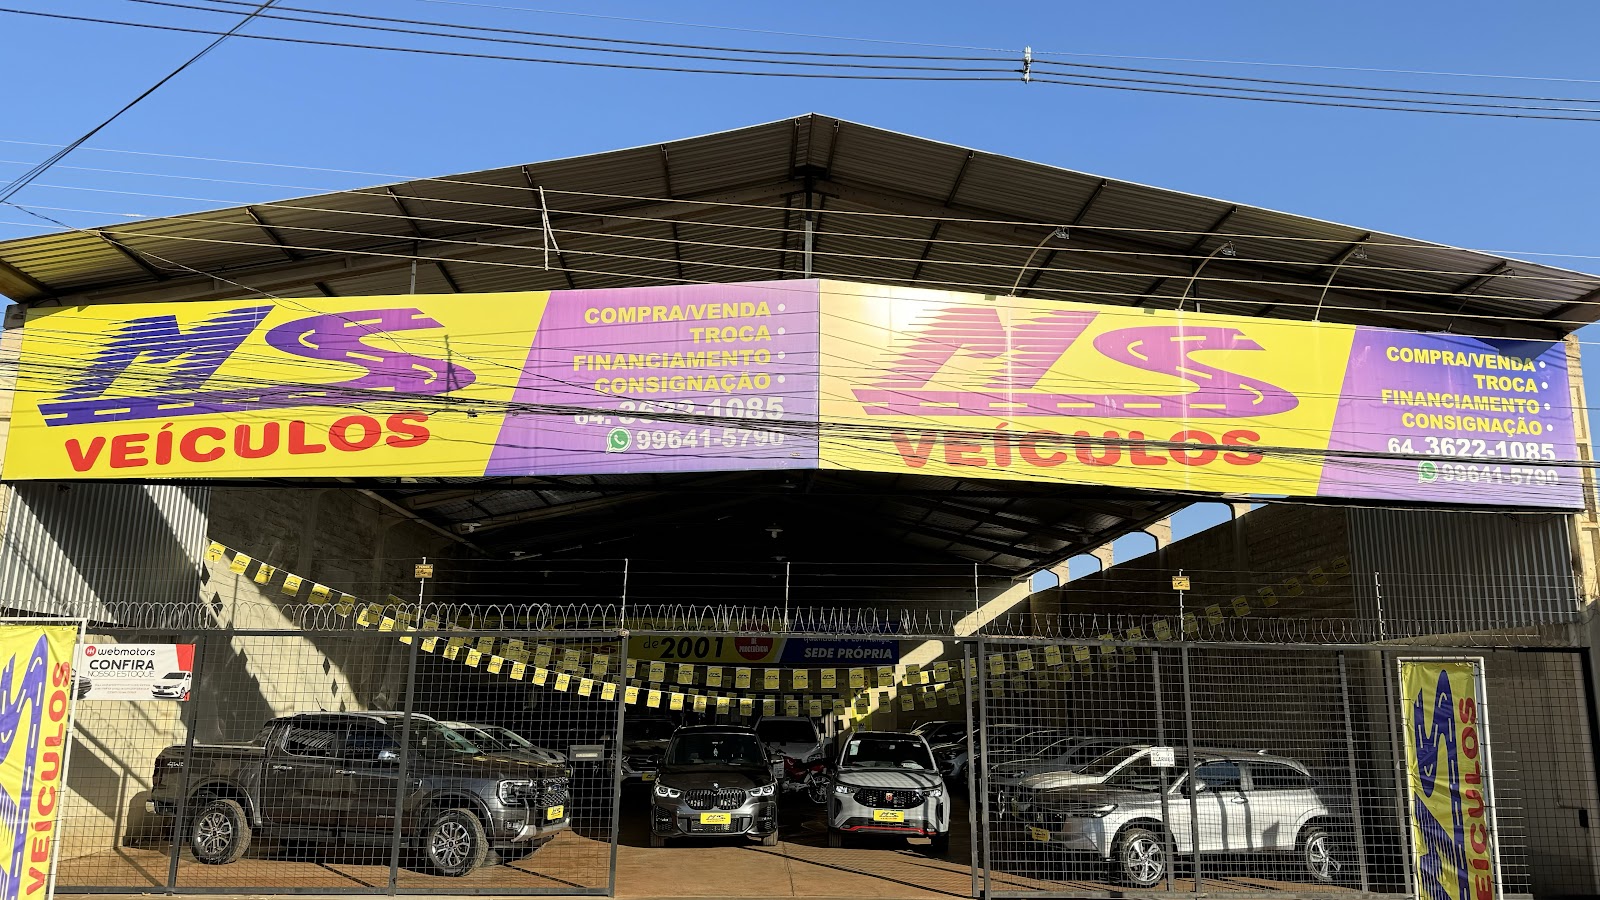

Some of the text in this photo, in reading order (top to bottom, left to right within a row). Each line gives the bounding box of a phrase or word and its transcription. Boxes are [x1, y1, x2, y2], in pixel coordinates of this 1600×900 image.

[584, 301, 771, 324] COMPRA/VENDA
[690, 325, 771, 344] TROCA
[37, 304, 477, 427] MS
[573, 349, 771, 371] FINANCIAMENTO
[851, 308, 1300, 417] MS
[1386, 346, 1536, 372] COMPRA/VENDA
[594, 371, 771, 394] CONSIGNAÇÃO
[1473, 374, 1538, 393] TROCA
[1381, 389, 1540, 415] FINANCIAMENTO
[1402, 413, 1543, 437] CONSIGNAÇÃO
[65, 412, 430, 472] VEÍCULOS
[889, 422, 1264, 468] VEÍCULOS
[1424, 437, 1556, 461] 3622-1085
[98, 647, 155, 656] webmotors
[660, 637, 724, 659] 2001
[804, 646, 892, 659] SEDE PRÓPRIA
[89, 660, 155, 670] CONFIRA
[27, 661, 70, 895] VEÍCULOS
[1459, 697, 1494, 900] EÍCULOS
